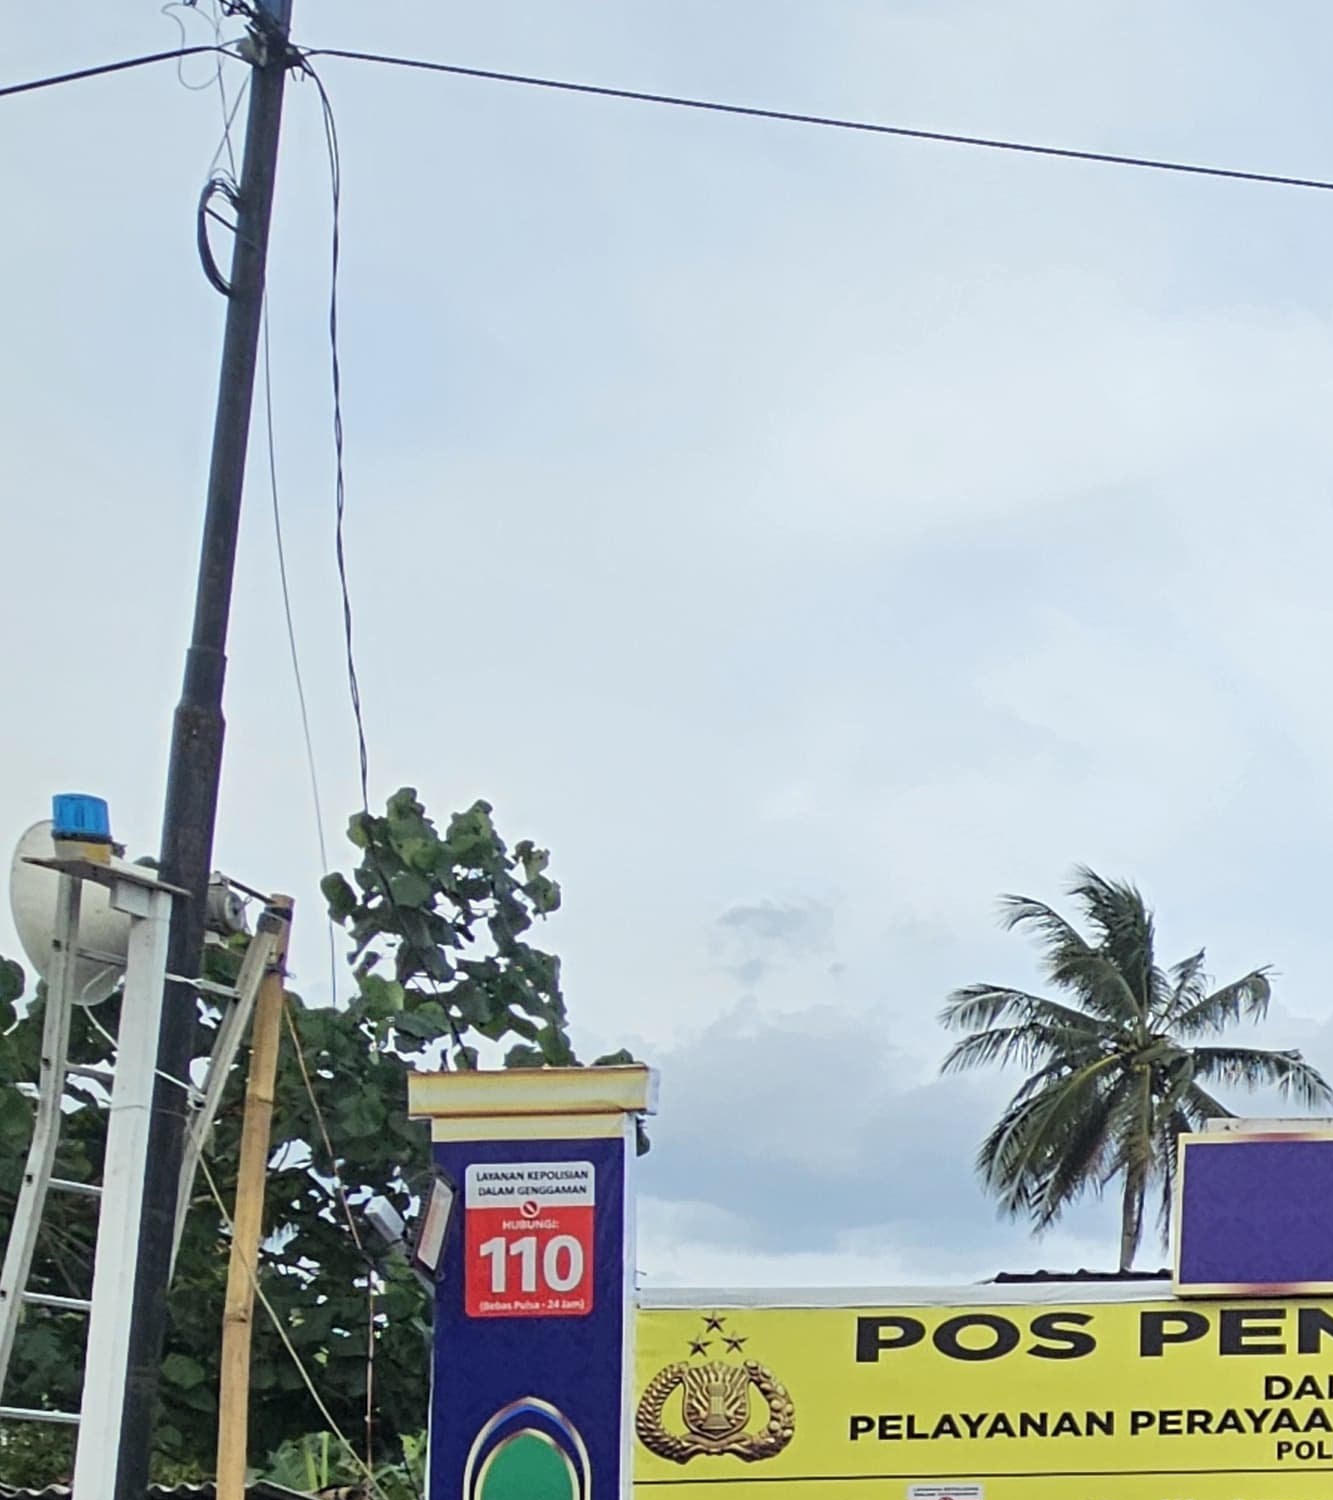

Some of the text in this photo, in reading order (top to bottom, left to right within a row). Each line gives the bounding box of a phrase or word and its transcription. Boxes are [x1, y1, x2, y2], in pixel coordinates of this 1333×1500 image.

[477, 1170, 589, 1182] LAYANAN KEPOLISIAN
[478, 1185, 587, 1197] DALAM GENGGAMAN
[479, 1234, 584, 1294] 110
[513, 1300, 540, 1311] Pulsa
[547, 1299, 560, 1310] 24
[561, 1298, 585, 1311] Jam)
[855, 1312, 1097, 1363] POS
[849, 1411, 1116, 1442] PELAYANAN
